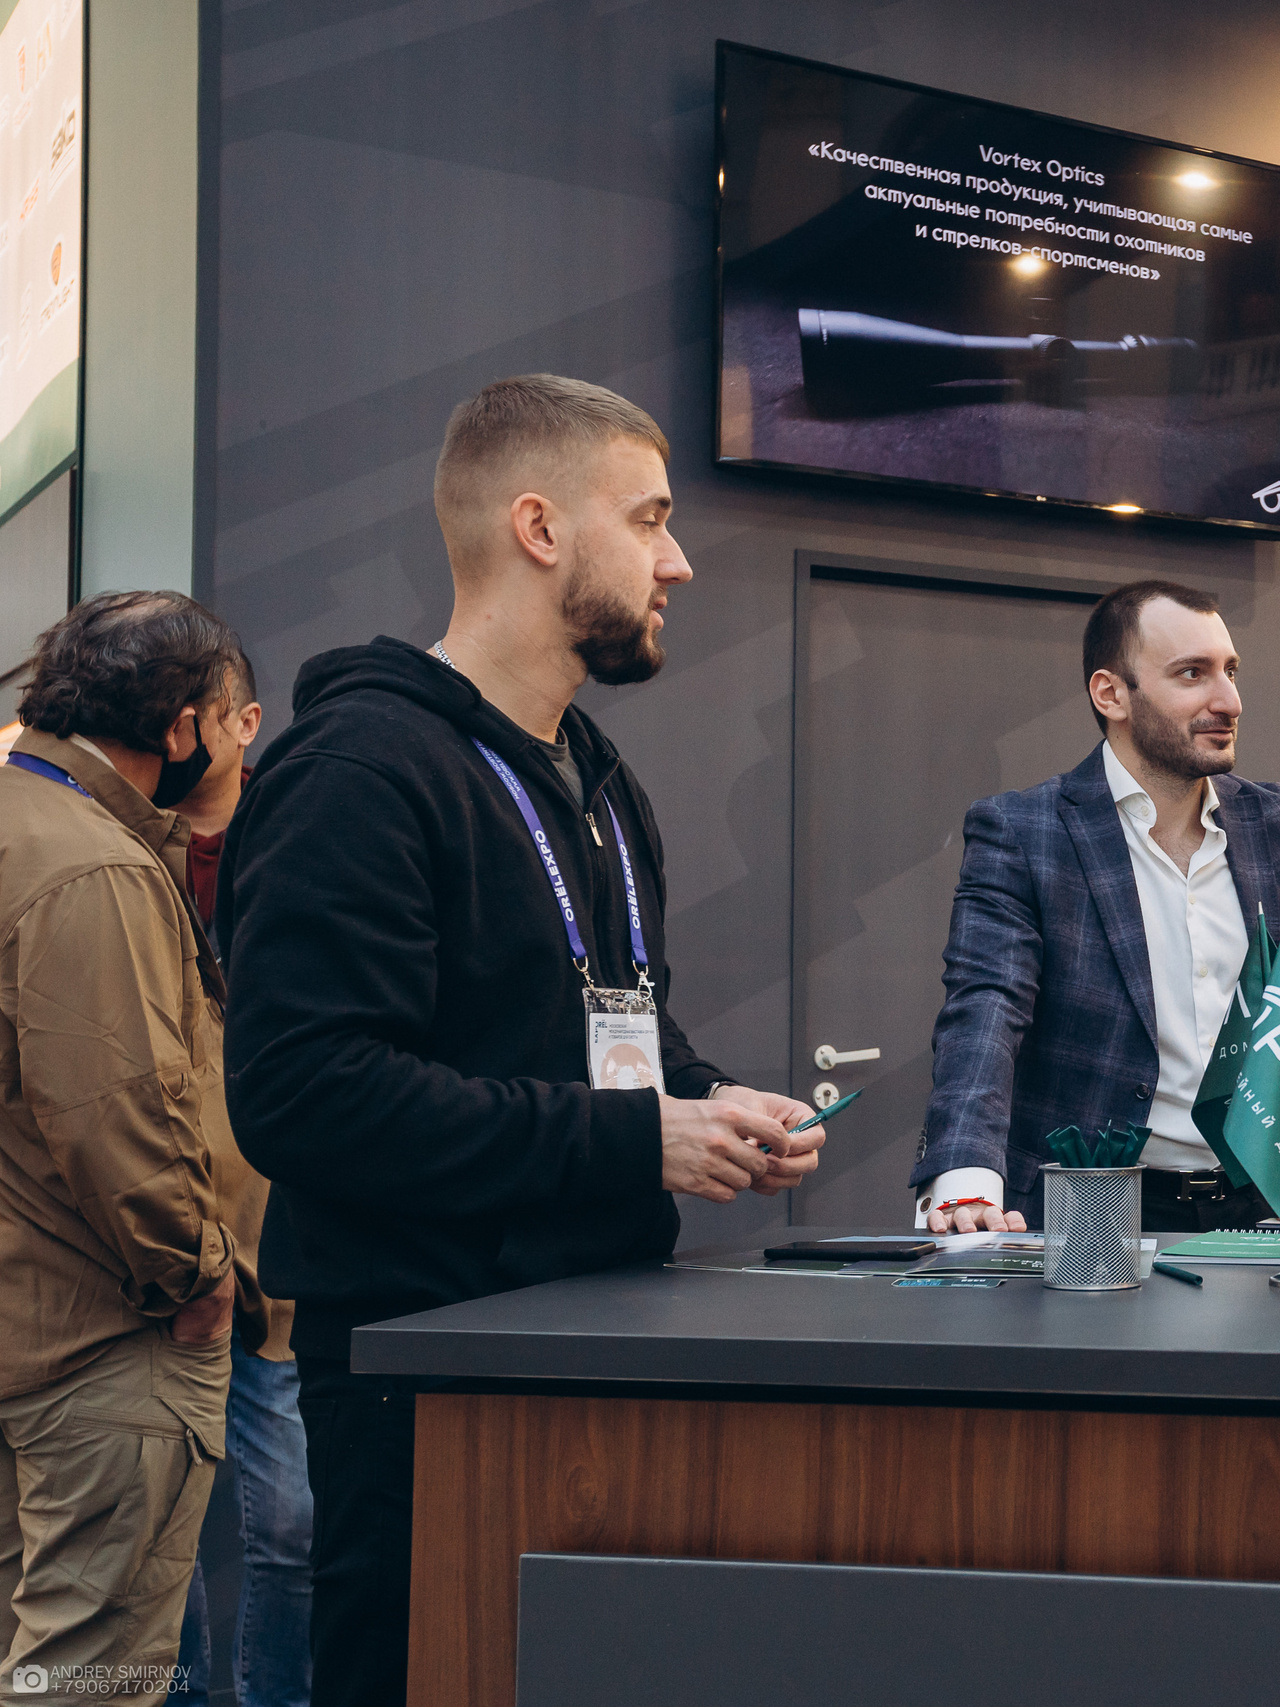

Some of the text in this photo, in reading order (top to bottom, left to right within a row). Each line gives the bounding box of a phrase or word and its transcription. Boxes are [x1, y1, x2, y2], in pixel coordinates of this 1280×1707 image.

[808, 141, 1253, 245] «Качественная продукция, учитывающая самые
[979, 145, 1105, 187] Vortex Optics
[864, 184, 1206, 262] актуальные потребности охотников
[915, 224, 1161, 281] и стрелков-спортсменов»
[534, 829, 575, 922] ORËLEXPO
[619, 843, 641, 930] ORËLEXPO
